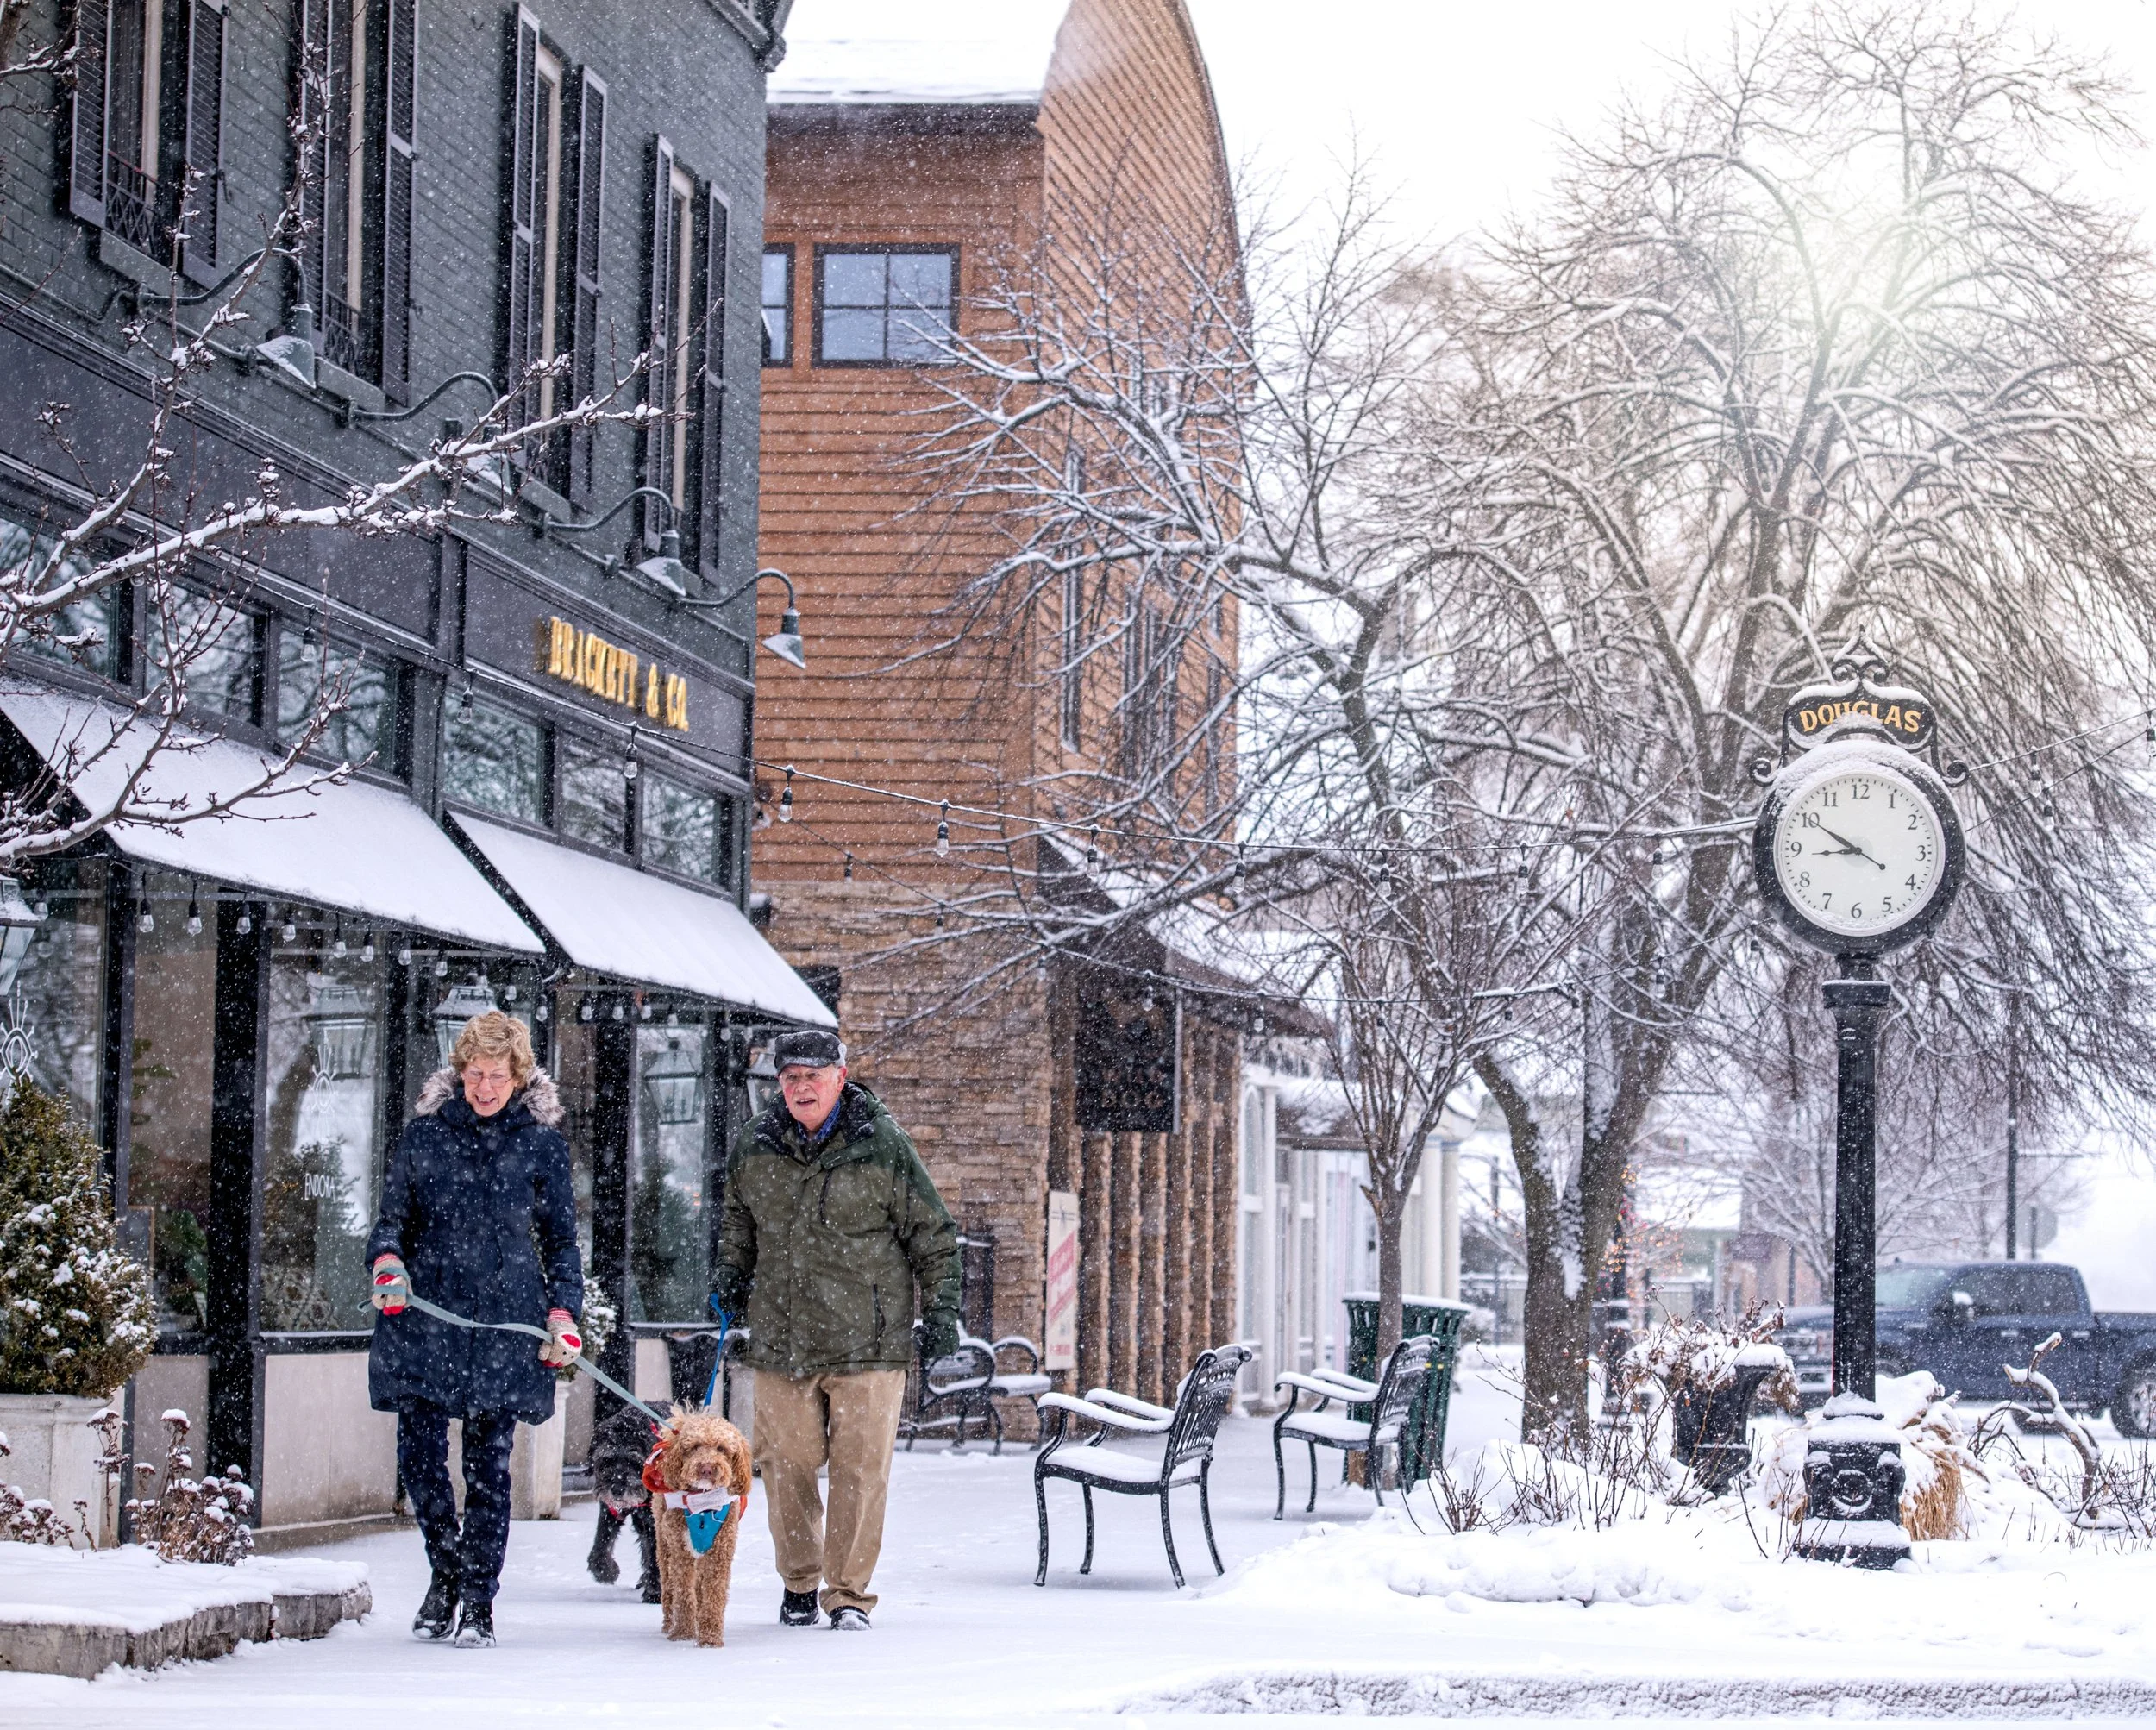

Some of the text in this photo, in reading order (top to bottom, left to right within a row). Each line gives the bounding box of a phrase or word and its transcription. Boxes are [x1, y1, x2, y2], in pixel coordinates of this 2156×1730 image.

[548, 615, 639, 709] BRACKETT
[645, 662, 659, 718] &
[1799, 699, 1922, 733] DOUGLAS
[1823, 791, 1839, 807] 11
[1852, 784, 1871, 799] 12
[1888, 793, 1896, 809] 1
[1801, 812, 1821, 828] 10
[1908, 814, 1918, 830] 2
[1790, 841, 1802, 857] 9
[1915, 844, 1927, 862] 3
[1799, 871, 1810, 887] 8
[1905, 874, 1916, 890] 4
[1821, 893, 1833, 910] 7
[1881, 896, 1892, 912] 5
[1851, 902, 1862, 919] 6
